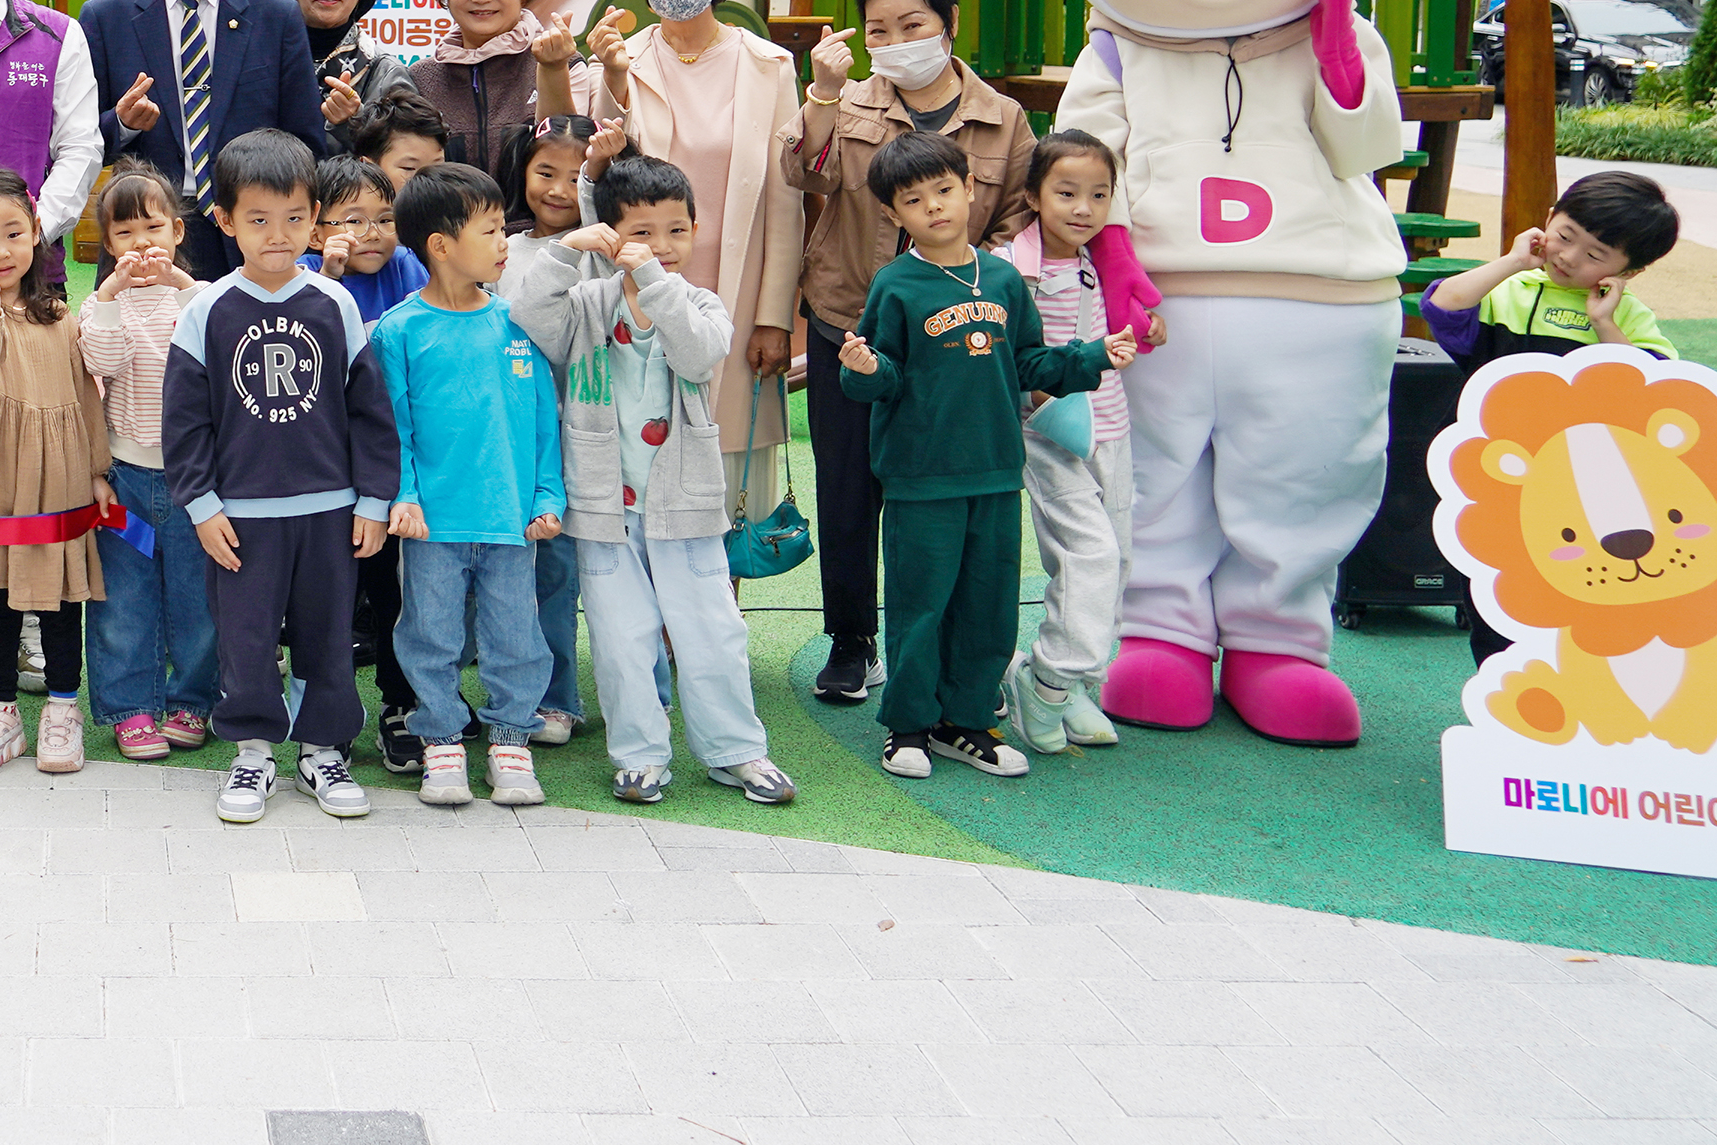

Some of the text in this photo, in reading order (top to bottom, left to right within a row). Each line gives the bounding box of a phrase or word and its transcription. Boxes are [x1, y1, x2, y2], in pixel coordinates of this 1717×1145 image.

[6, 71, 49, 88] 동대문구
[1198, 175, 1275, 246] D
[247, 316, 305, 341] OLBN
[245, 343, 313, 397] 19 R 90
[242, 388, 317, 423] No. 925 NY
[1503, 776, 1717, 827] 마로니에 어린
